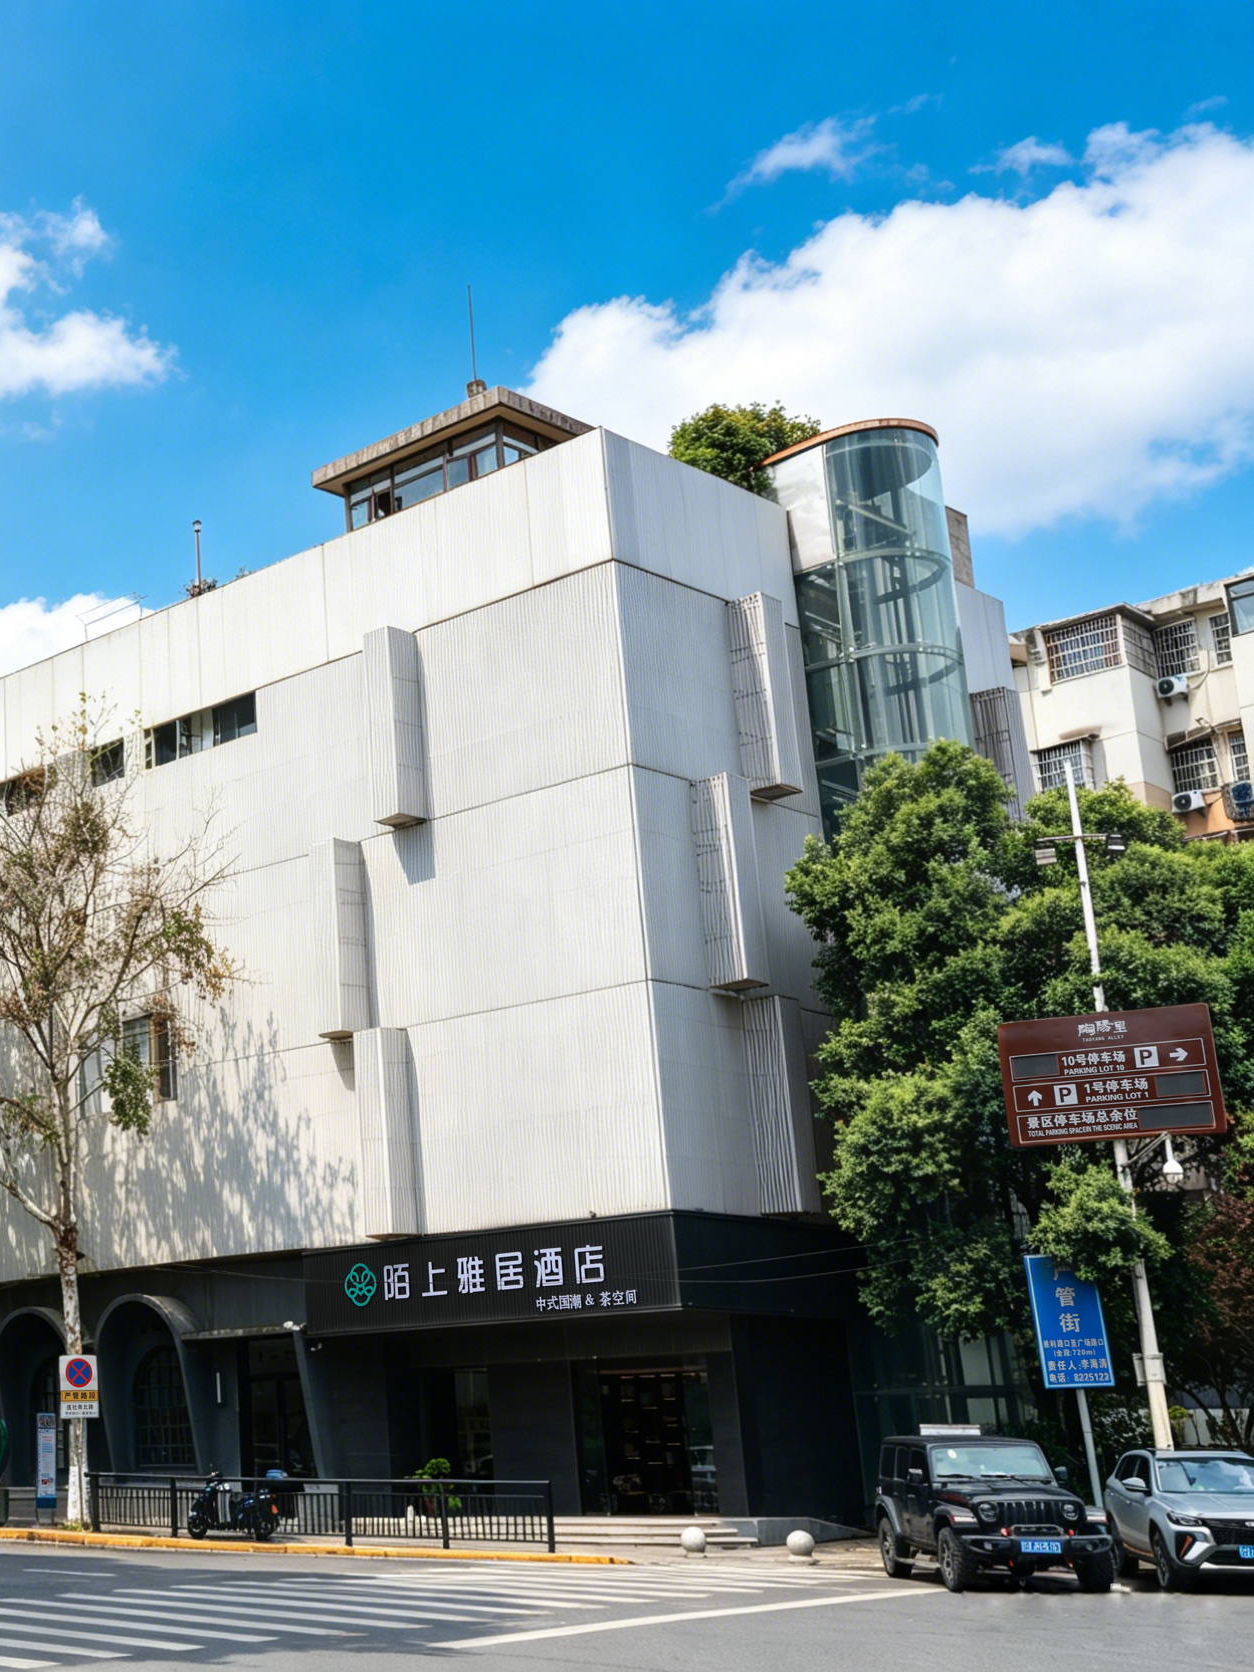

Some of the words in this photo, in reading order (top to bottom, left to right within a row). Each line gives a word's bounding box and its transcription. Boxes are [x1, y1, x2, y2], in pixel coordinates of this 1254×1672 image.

[1061, 1051, 1126, 1066] 10号停车场
[1064, 1067, 1097, 1075] PARKING
[1084, 1078, 1148, 1094] 1号停车场
[1086, 1094, 1123, 1103] PARKING
[1027, 1109, 1138, 1129] 景区停车场总余位
[1028, 1129, 1045, 1137] TOTAL
[1046, 1128, 1068, 1136] PARKING
[1104, 1123, 1122, 1131] SCENIC
[383, 1244, 605, 1300] 陌上雅居酒店
[536, 1294, 582, 1312] 中式国潮
[585, 1294, 595, 1306] &
[599, 1289, 637, 1307] 茶空间
[1044, 1339, 1104, 1348] 胜利路口至广场路口
[1074, 1373, 1109, 1382] 8225122
